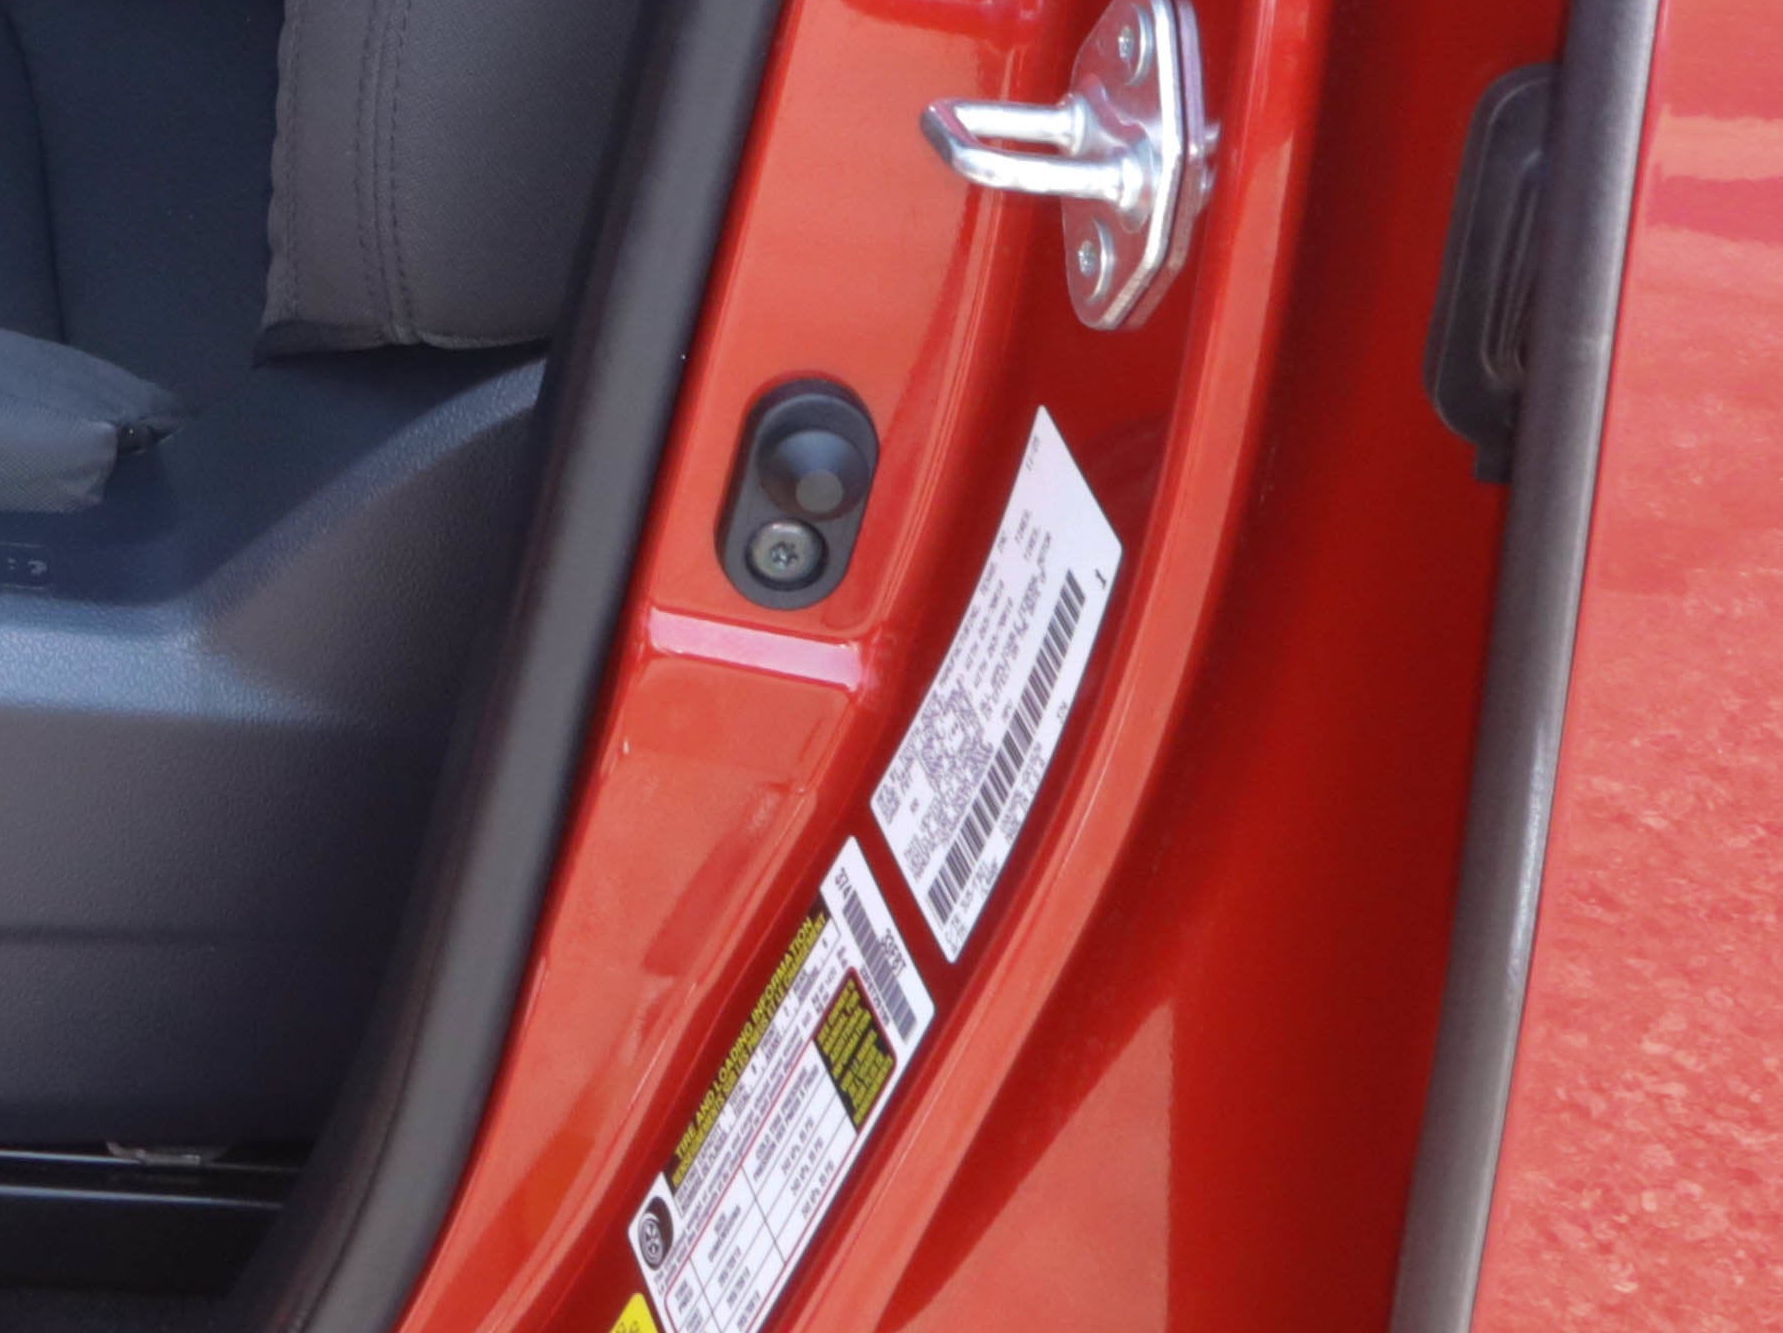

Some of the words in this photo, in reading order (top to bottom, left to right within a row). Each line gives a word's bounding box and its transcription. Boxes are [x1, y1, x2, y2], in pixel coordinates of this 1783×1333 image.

[676, 1124, 696, 1158] TIRE
[695, 1090, 714, 1124] AND
[714, 1023, 752, 1089] LOADING
[752, 917, 810, 1021] INFORMATION
